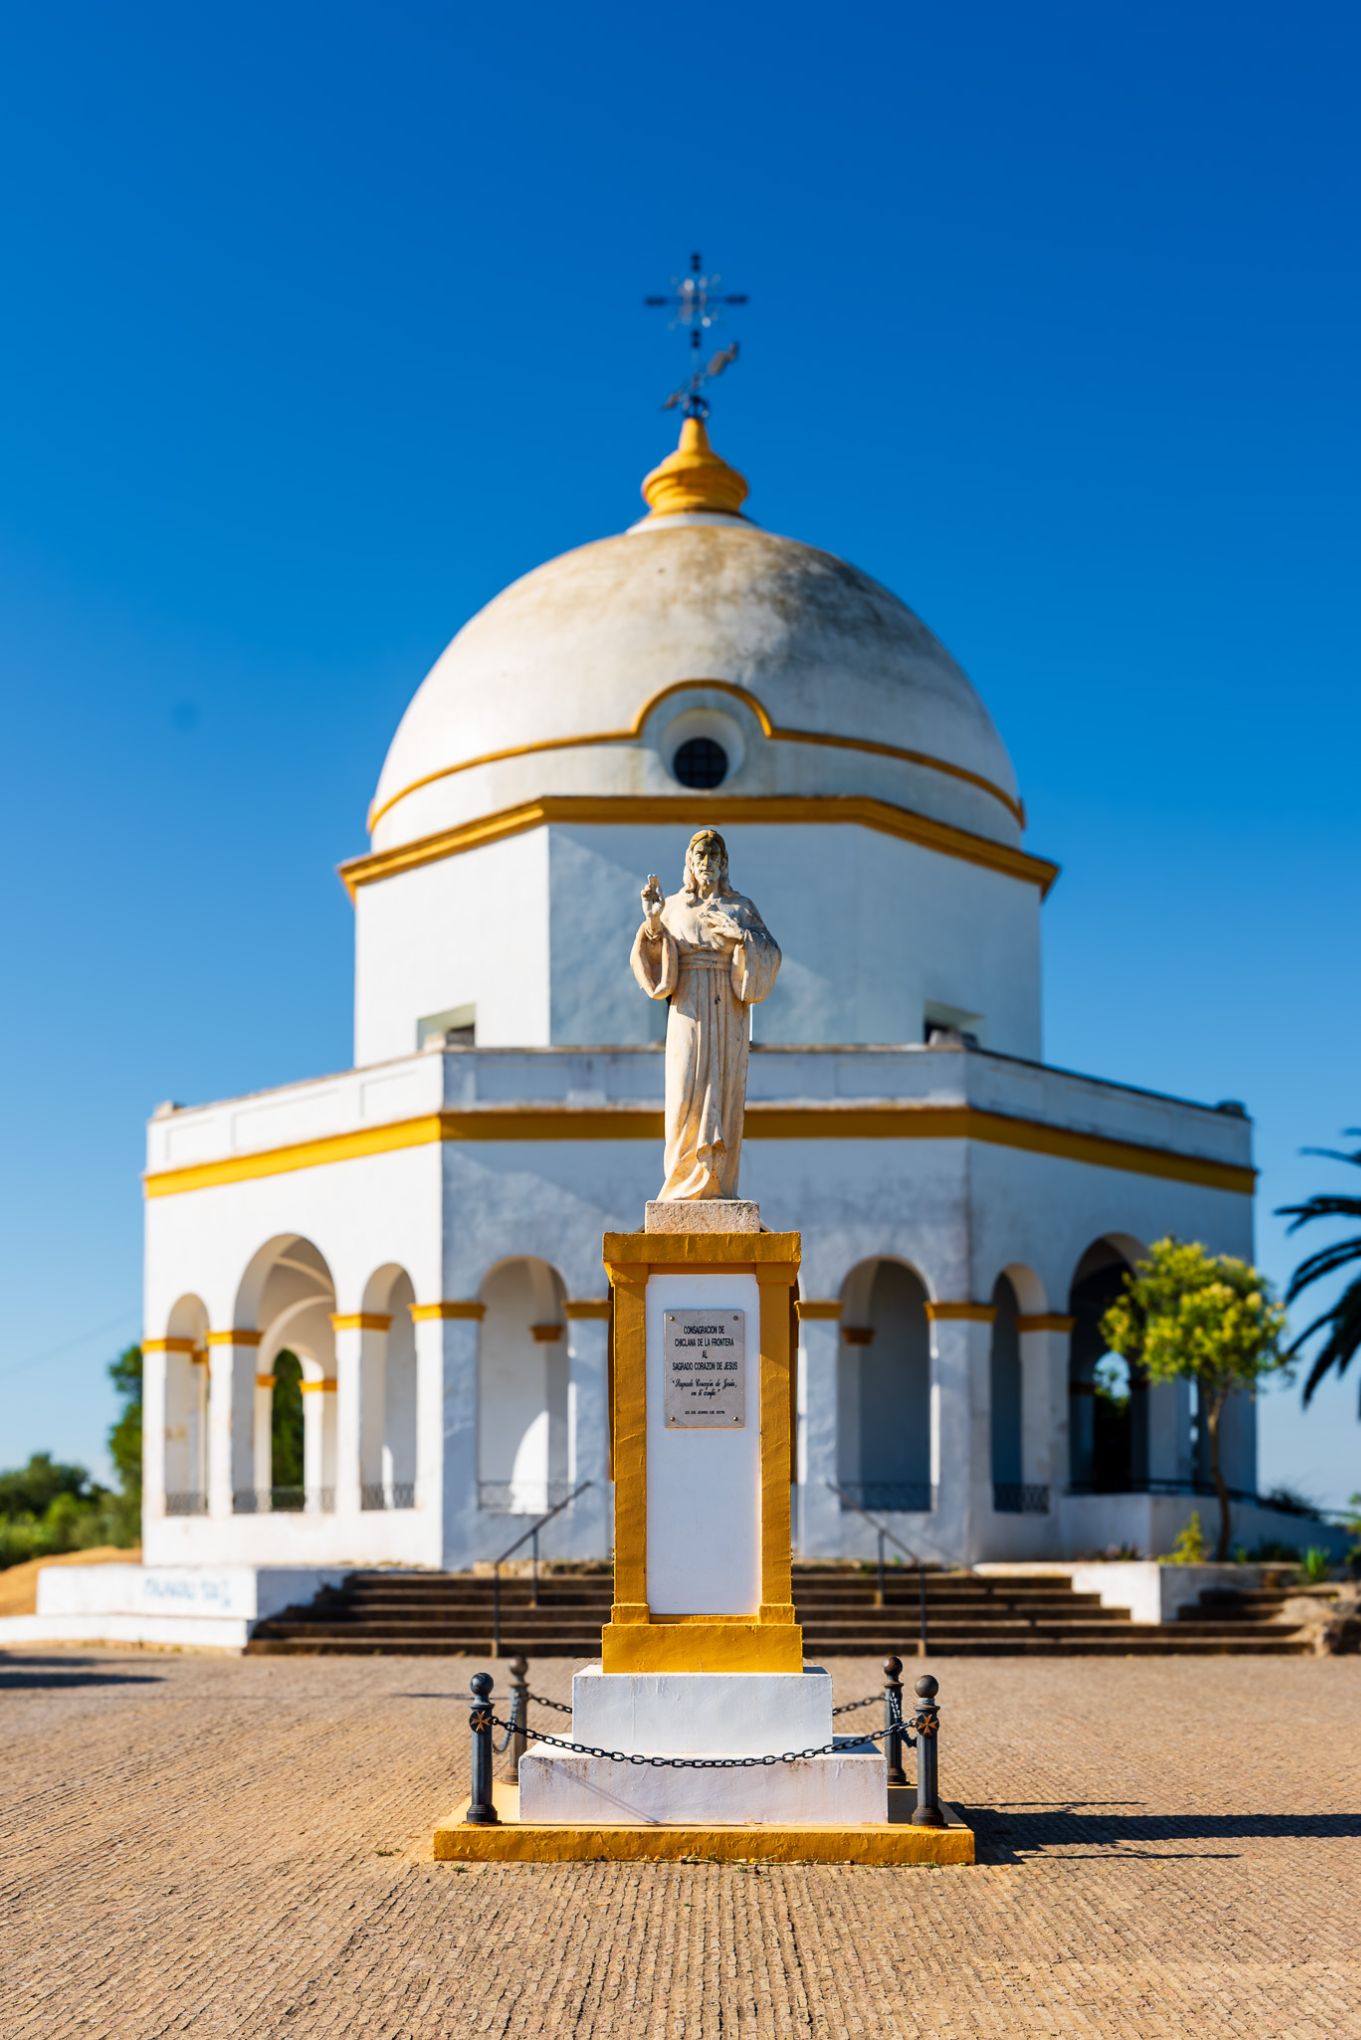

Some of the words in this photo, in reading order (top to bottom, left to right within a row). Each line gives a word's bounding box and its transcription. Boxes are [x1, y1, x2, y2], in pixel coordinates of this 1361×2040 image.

[684, 1325, 717, 1334] CONSAGRACION
[719, 1325, 725, 1334] DE
[675, 1338, 696, 1347] CHICLANA
[697, 1338, 703, 1346] DE
[704, 1338, 710, 1346] LA
[712, 1338, 734, 1346] FRONTERA
[702, 1350, 708, 1359] AL
[672, 1362, 693, 1371] SAGRADO
[694, 1362, 715, 1370] CORAZON
[717, 1362, 723, 1370] DE
[724, 1362, 738, 1370] JESUS
[715, 1379, 721, 1387] de
